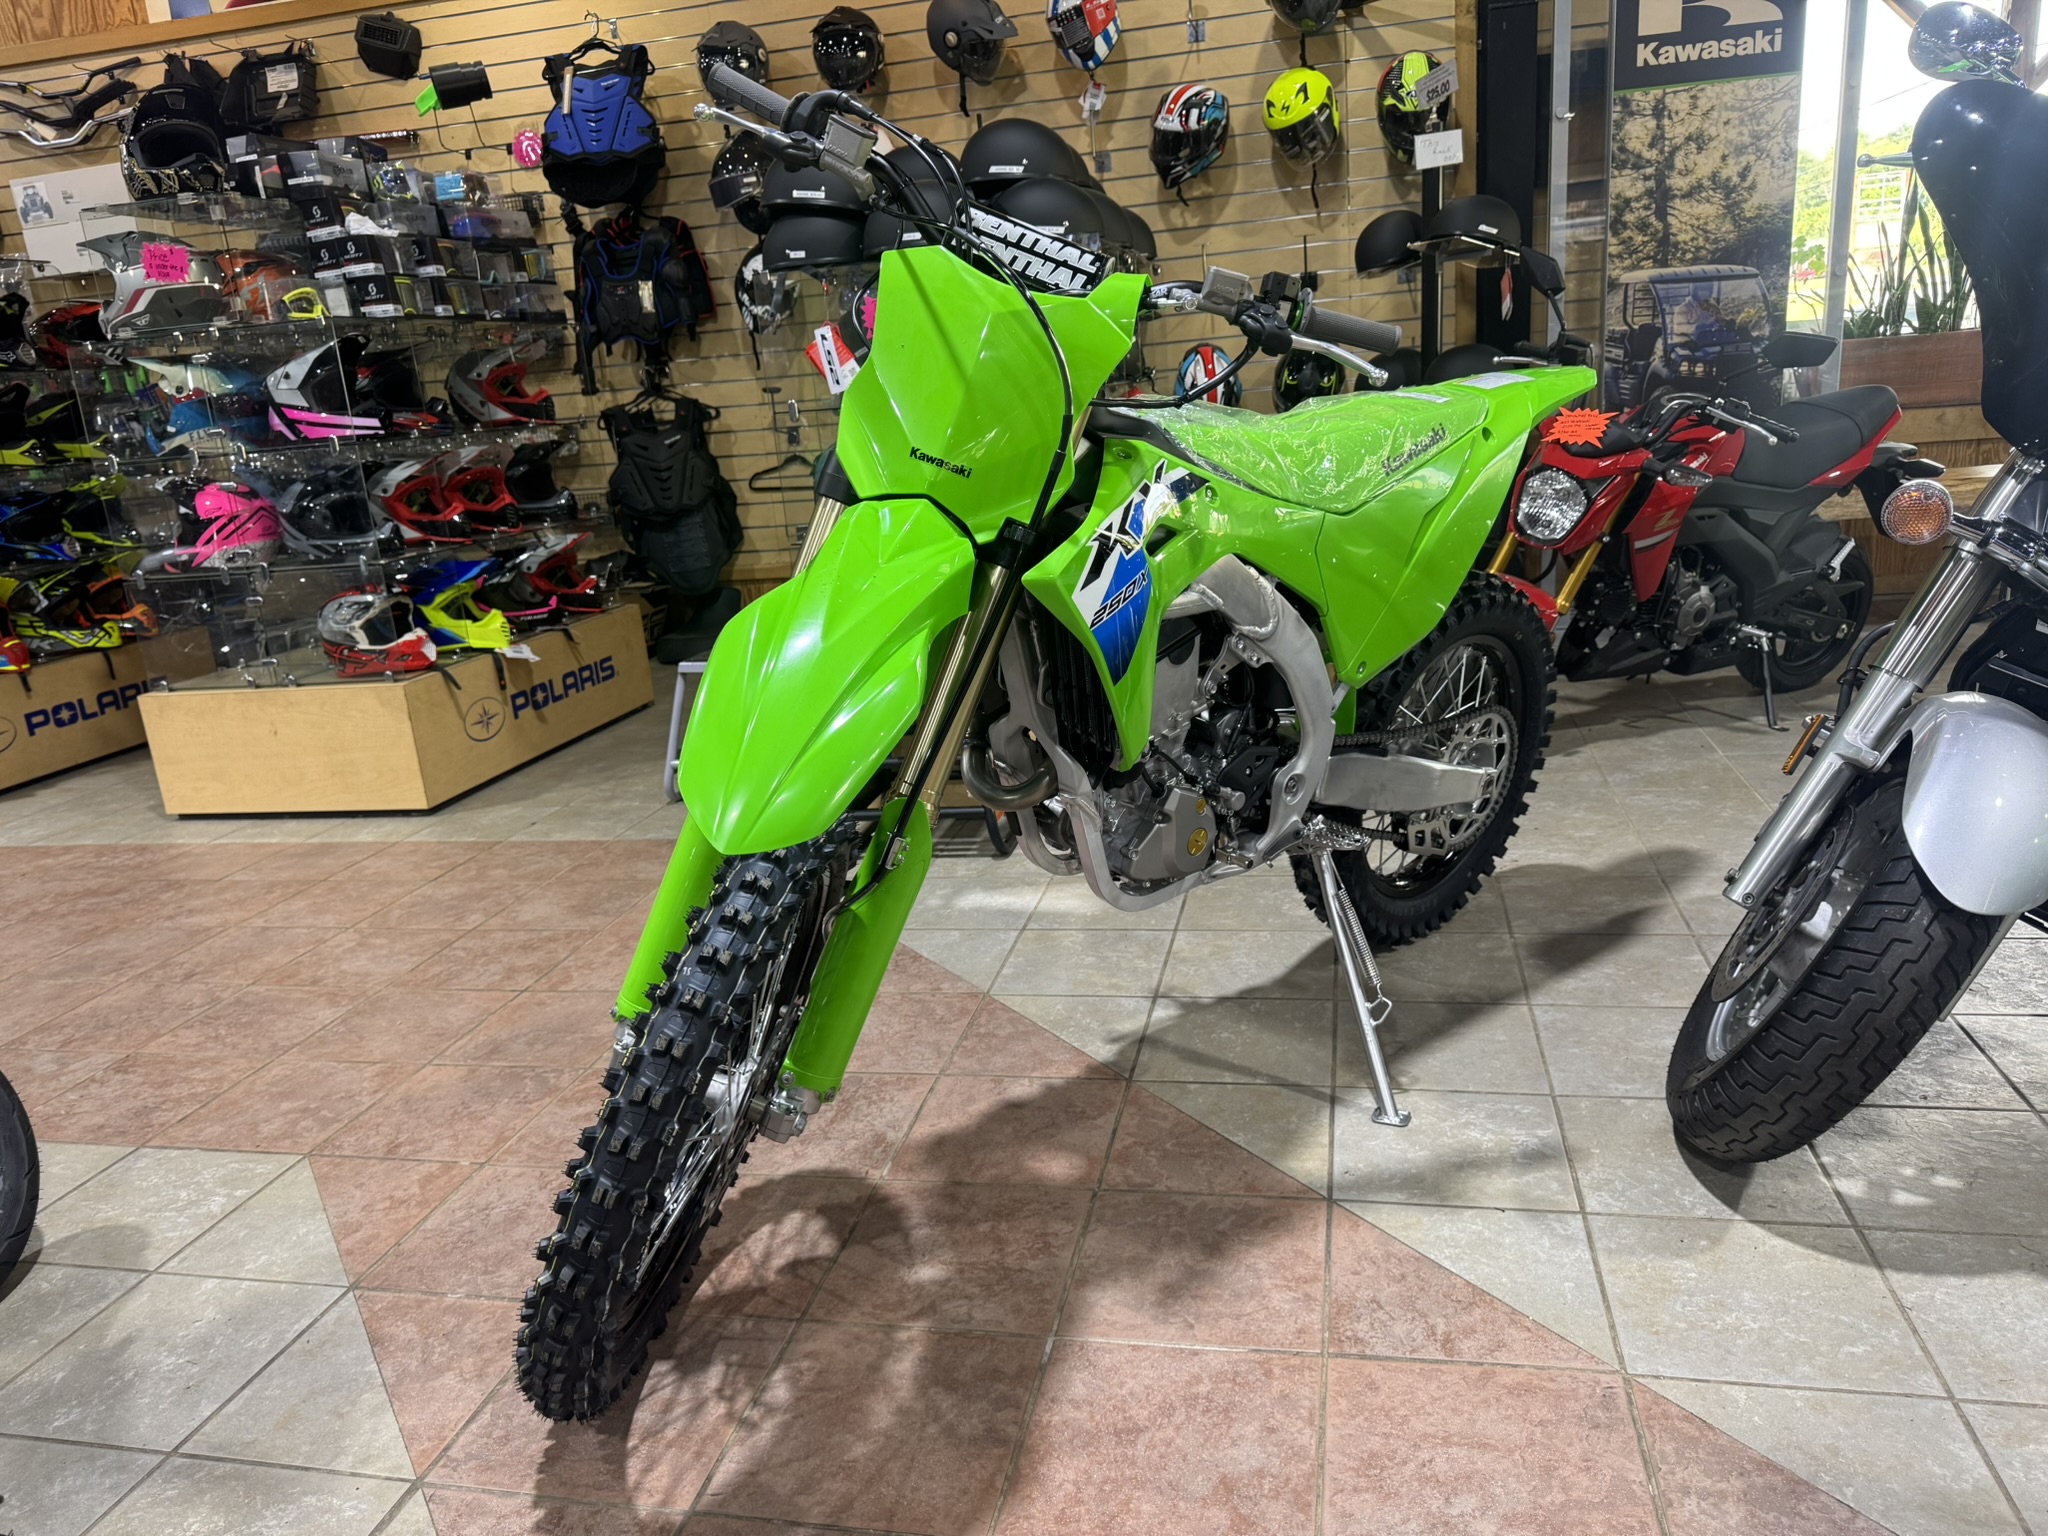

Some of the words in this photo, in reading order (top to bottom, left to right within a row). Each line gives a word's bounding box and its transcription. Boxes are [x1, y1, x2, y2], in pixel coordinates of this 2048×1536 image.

[1636, 28, 1783, 67] Kawasaki
[1426, 79, 1450, 103] $25.00
[344, 251, 363, 259] SCOTT
[961, 206, 1101, 274] RENTHAL
[952, 235, 1092, 290] ENTHAL
[364, 293, 384, 301] SCOTT
[909, 446, 973, 479] Kawasaki
[510, 655, 616, 720] POLARIS
